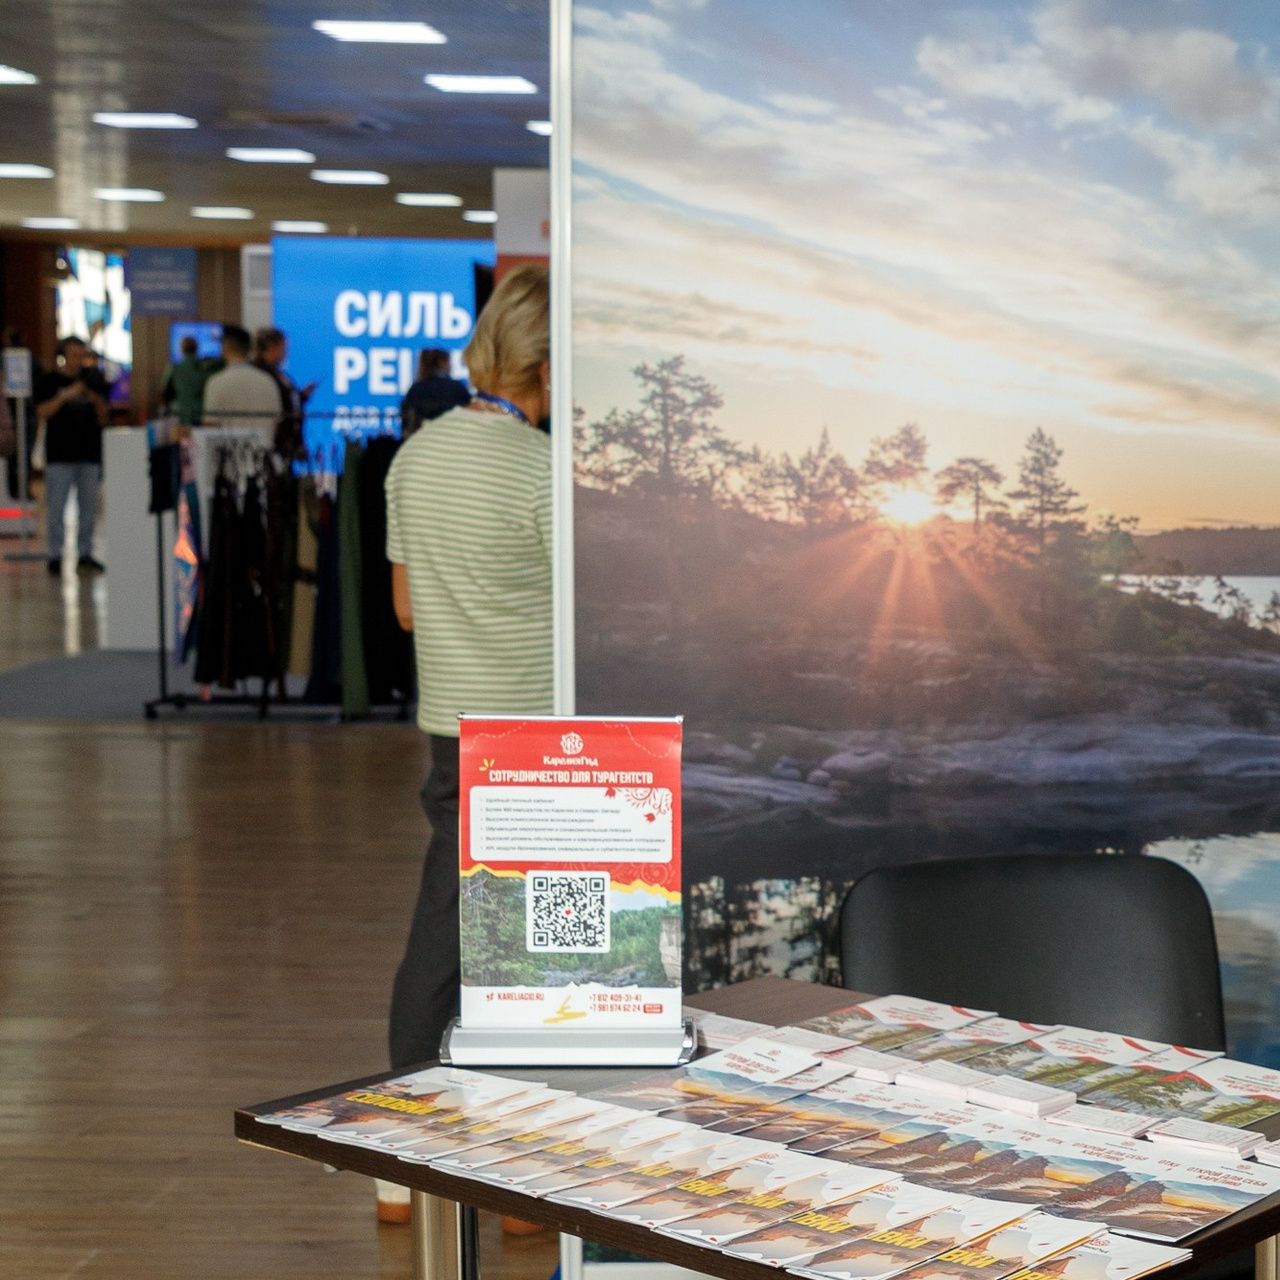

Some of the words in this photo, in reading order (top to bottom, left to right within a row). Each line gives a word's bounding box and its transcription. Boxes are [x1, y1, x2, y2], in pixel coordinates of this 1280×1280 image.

[334, 289, 472, 339] СИЛЬ
[489, 770, 570, 783] СОТРУДНИЧЕСТВО
[571, 771, 590, 783] ДЛЯ
[593, 772, 653, 784] ТУРАГЕНТСТВ
